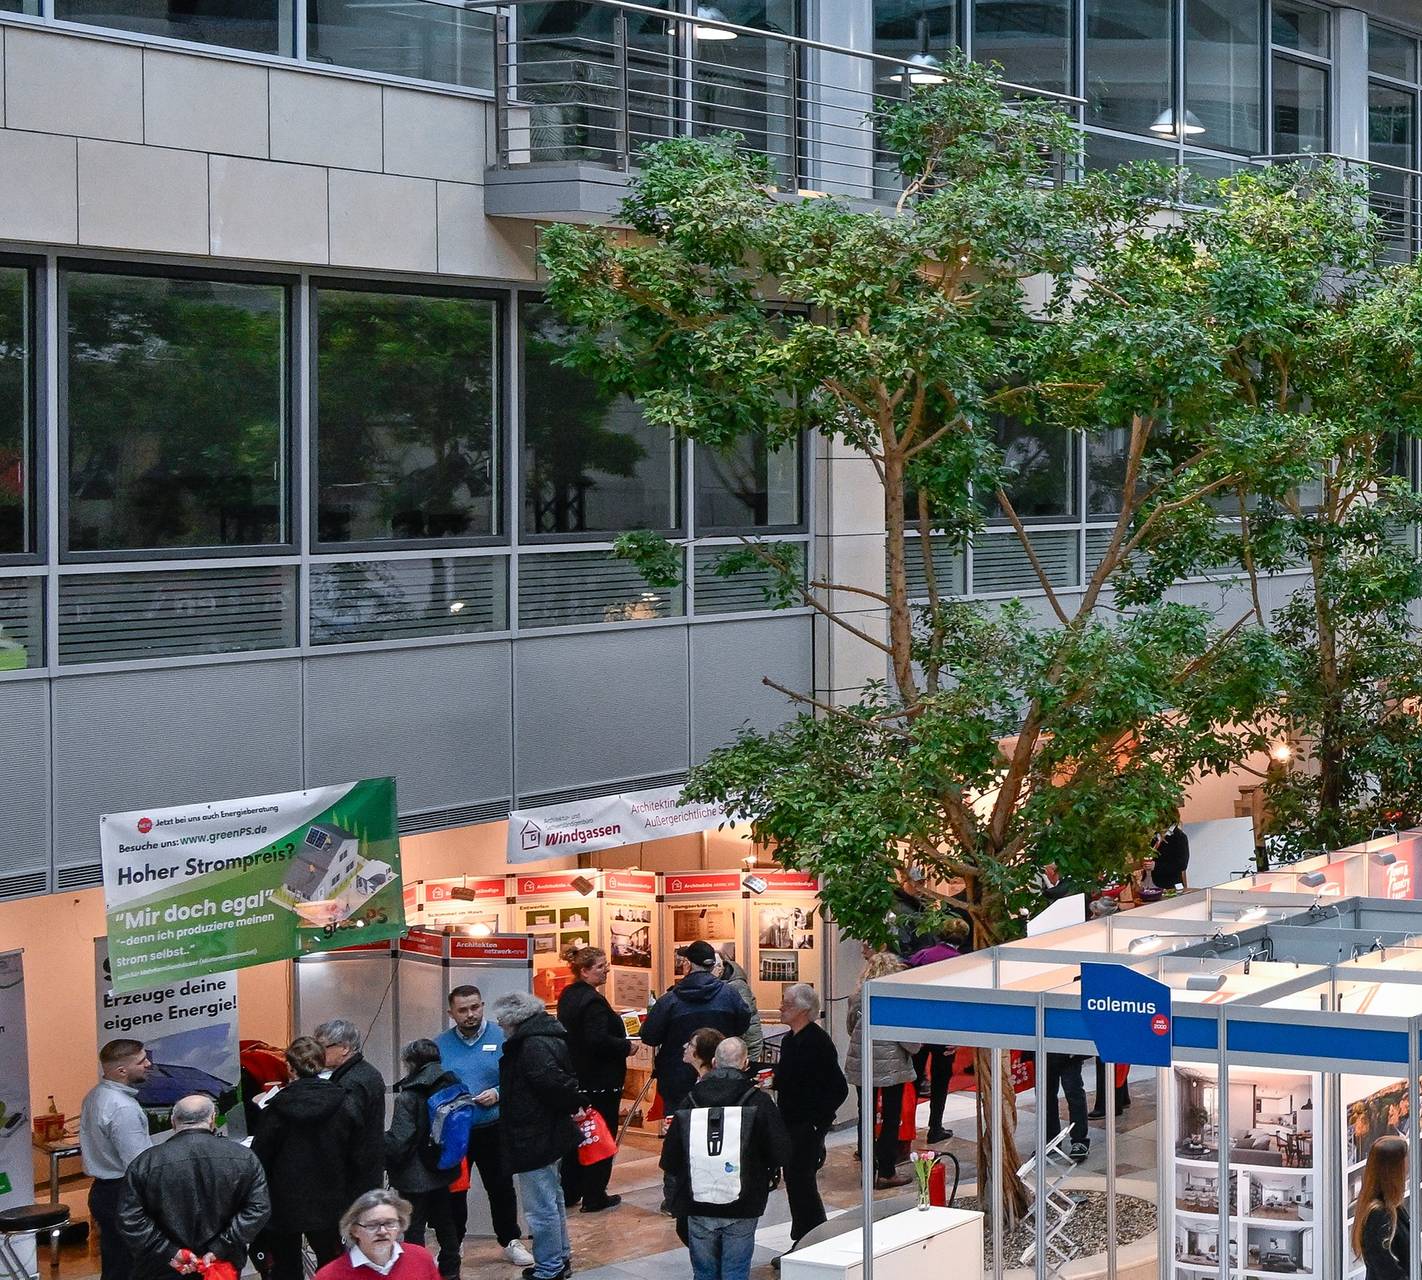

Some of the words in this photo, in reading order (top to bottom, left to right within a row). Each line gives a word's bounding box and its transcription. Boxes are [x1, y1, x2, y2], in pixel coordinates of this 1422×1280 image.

[155, 817, 174, 827] Jetzt
[175, 815, 187, 824] bei
[188, 815, 201, 823] uns
[202, 811, 219, 821] auch
[221, 805, 279, 818] Energieberatung
[631, 798, 675, 815] Architektin
[645, 807, 717, 828] Außergerichtliche
[119, 839, 158, 853] Besuche
[160, 839, 179, 849] uns:
[180, 825, 268, 845] www.greenPS.de
[545, 824, 621, 846] Windgassen
[118, 864, 179, 885] Hoher
[185, 843, 295, 876] Strompreis?
[165, 899, 217, 923] doch
[157, 928, 175, 941] ich
[176, 920, 235, 940] produziere
[236, 913, 275, 927] meinen
[456, 941, 498, 949] Architekten
[116, 954, 148, 967] Strom
[103, 986, 175, 1008] Erzeuge
[180, 980, 227, 996] deine
[1087, 996, 1156, 1014] colemus
[103, 1009, 163, 1031] eigene
[168, 995, 237, 1020] Energie!
